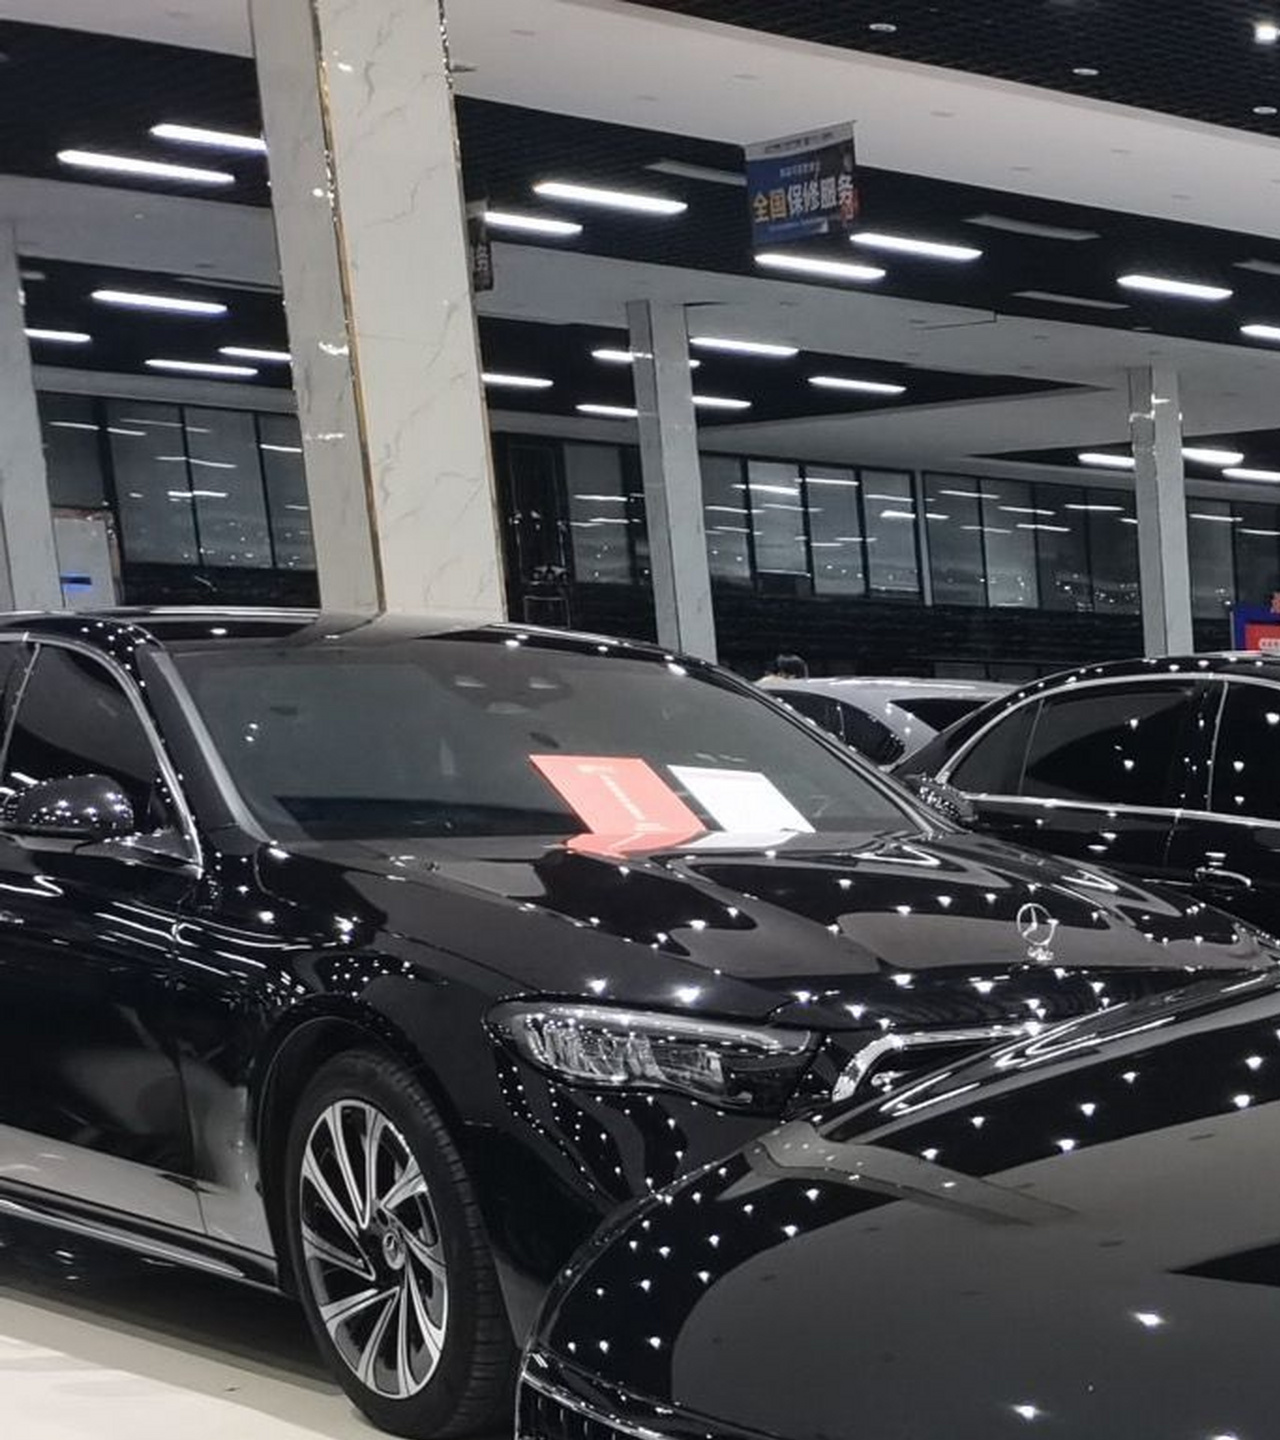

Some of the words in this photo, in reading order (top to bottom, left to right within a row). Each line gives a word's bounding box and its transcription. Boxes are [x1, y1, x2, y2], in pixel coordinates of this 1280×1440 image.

[752, 174, 855, 223] 全国保修服务
